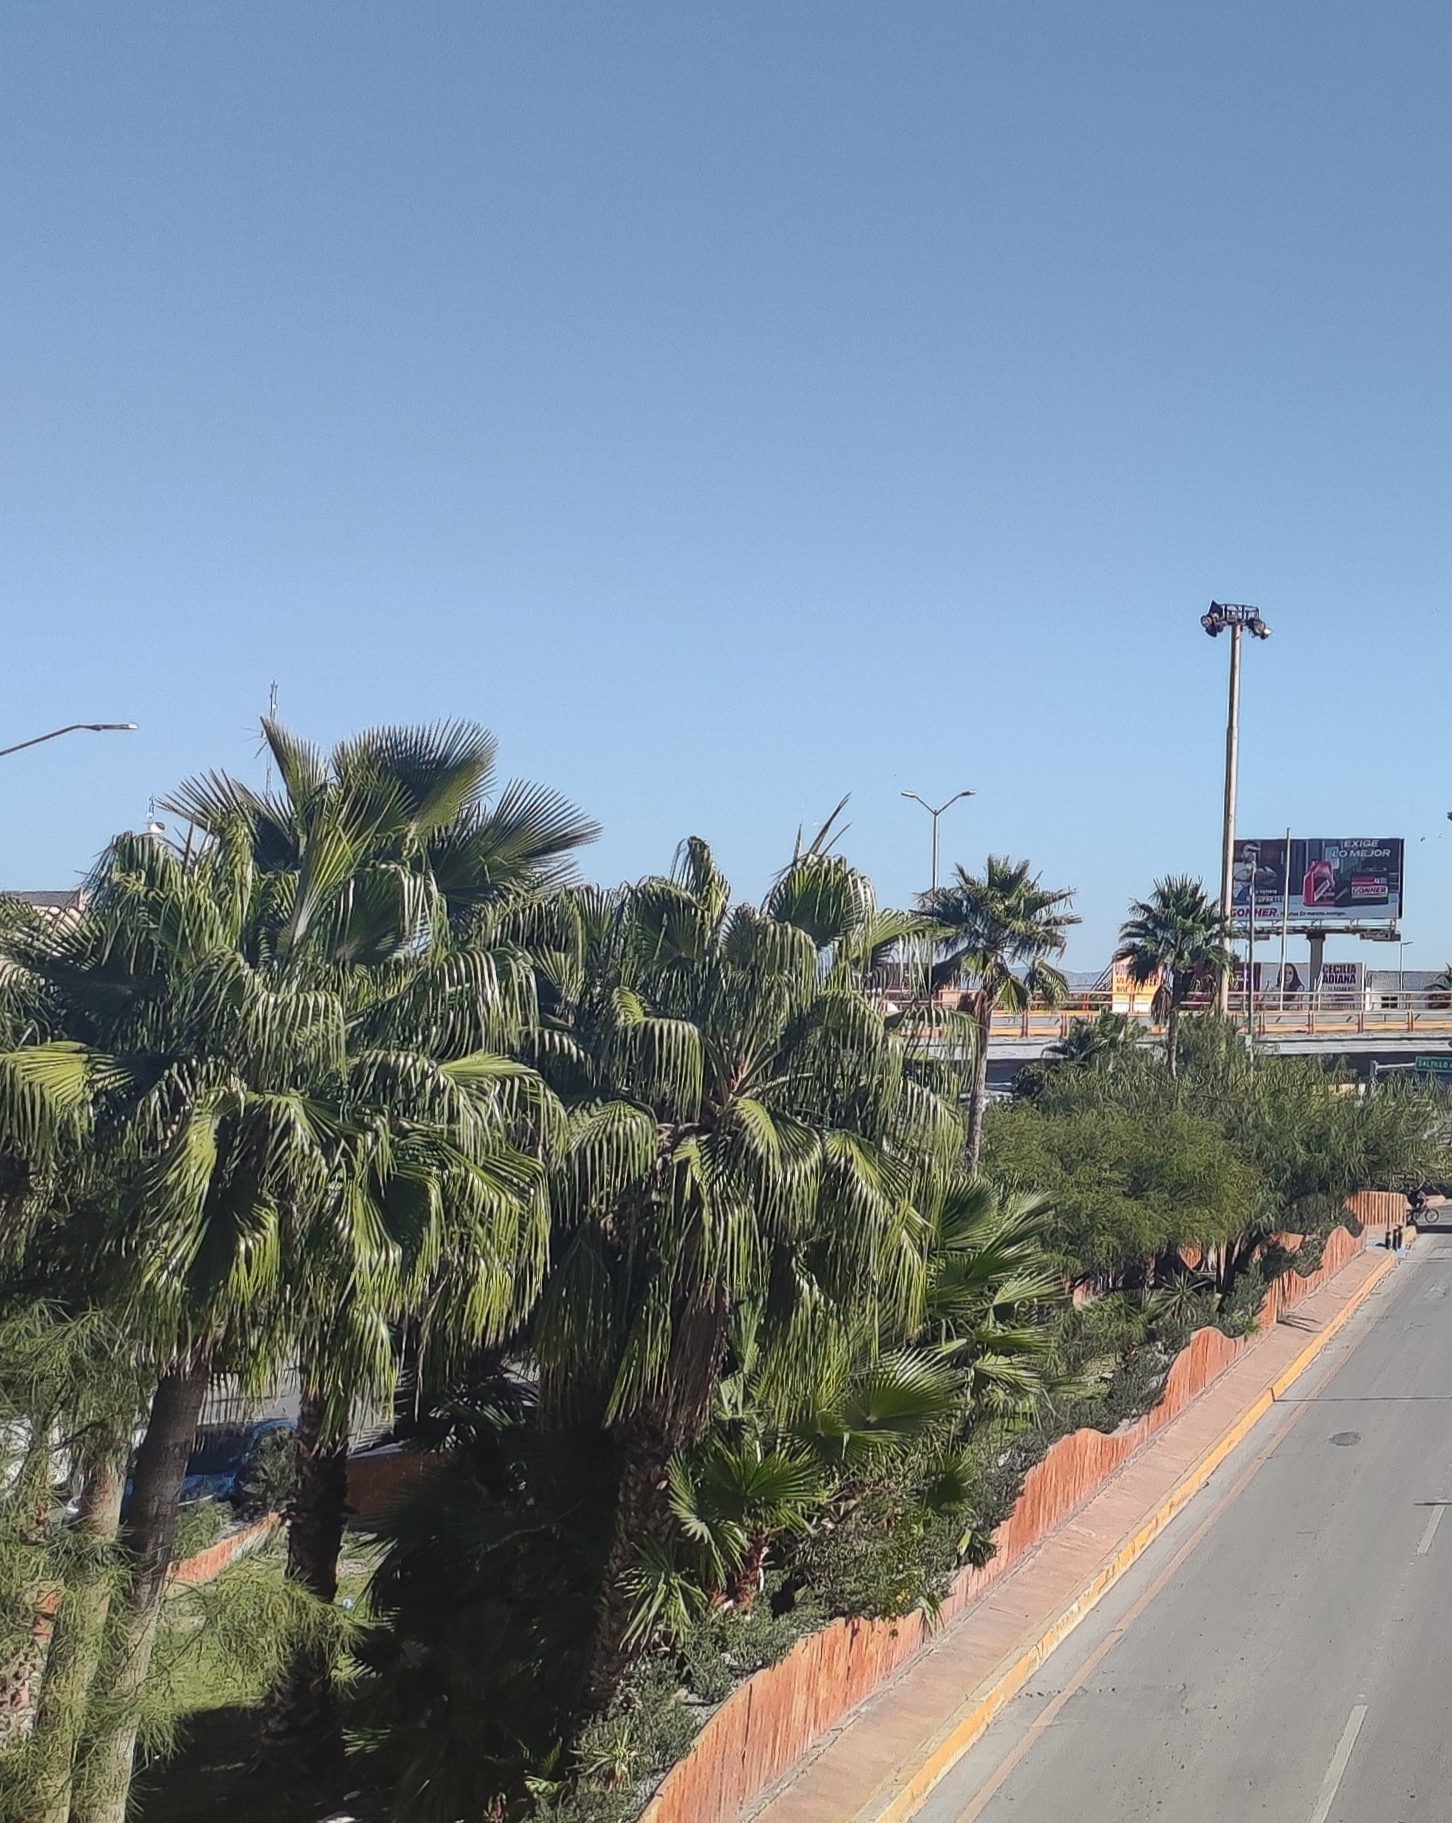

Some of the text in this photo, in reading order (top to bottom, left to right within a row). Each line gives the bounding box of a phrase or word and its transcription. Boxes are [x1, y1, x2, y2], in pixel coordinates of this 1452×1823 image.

[1344, 839, 1379, 848] EXIGE
[1332, 849, 1391, 858] LO MEJOR
[1322, 964, 1357, 974] CECILIA
[1418, 1060, 1448, 1069] SALTILLO
